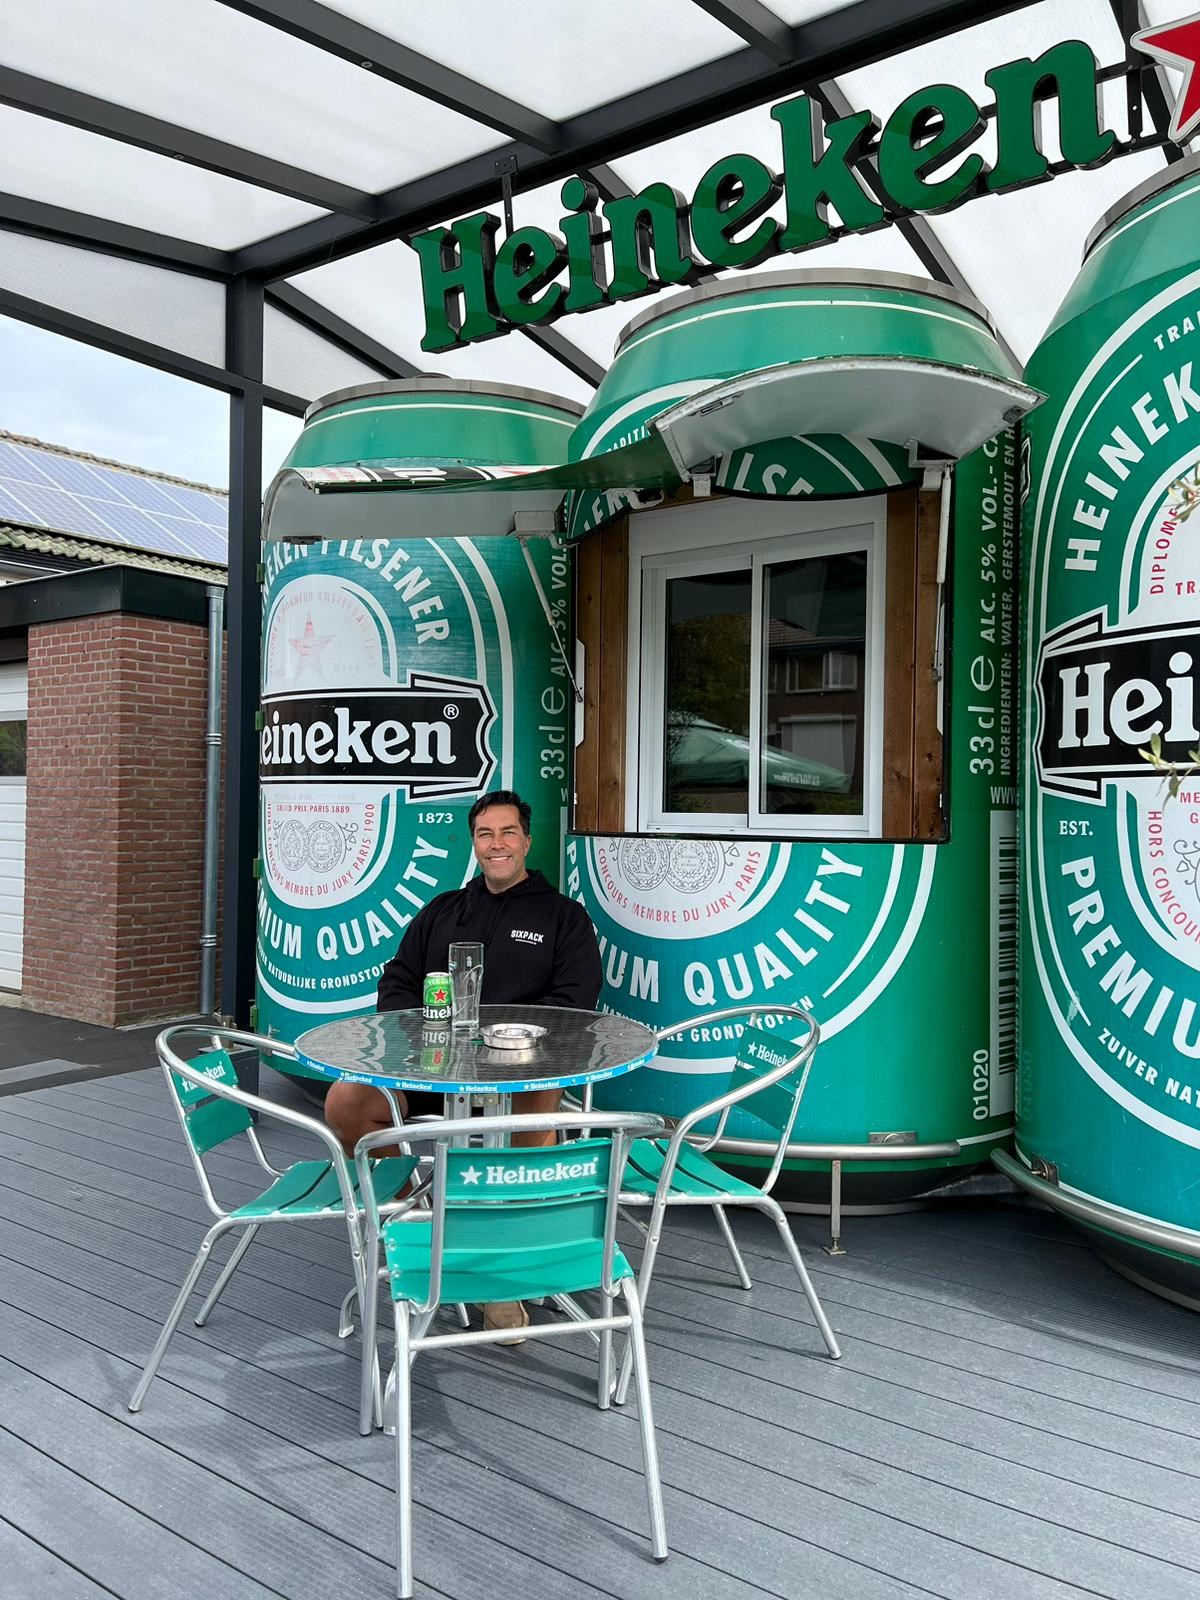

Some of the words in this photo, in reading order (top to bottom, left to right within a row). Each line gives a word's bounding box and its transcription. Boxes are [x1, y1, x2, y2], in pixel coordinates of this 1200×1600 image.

[409, 38, 1116, 352] Heineken
[1154, 311, 1200, 351] TRA
[1004, 444, 1015, 467] EN
[982, 478, 998, 531] VOL.
[1002, 475, 1015, 581] GERSTEMOUT
[981, 543, 997, 583] 5%
[1175, 581, 1200, 595] TR
[980, 592, 997, 643] ALC.
[1001, 587, 1014, 646] WATER,
[1000, 652, 1012, 776] INGREDIENTEN:
[1058, 650, 1200, 749] Hei
[261, 707, 457, 765] eineken
[967, 705, 995, 775] 33cl
[294, 805, 307, 813] PRIX
[309, 805, 330, 813] PARIS
[332, 805, 350, 814] 1889
[417, 813, 454, 824] 1873
[1059, 820, 1094, 836] EST.
[1148, 811, 1164, 858] HORS
[284, 880, 313, 896] MEMBRE
[317, 885, 329, 896] DU
[333, 870, 354, 891] JURY
[352, 838, 372, 871] PARIS
[364, 803, 375, 832] 1900
[317, 835, 449, 961] QUALITY
[598, 847, 628, 909] CONCOURS
[632, 902, 677, 923] MEMBRE
[683, 908, 700, 923] DU
[706, 891, 737, 918] JURY
[735, 850, 761, 892] PARIS
[511, 930, 544, 943] SIXPACK
[683, 847, 863, 1006] QUALITY
[973, 1049, 989, 1121] 01020
[1098, 1027, 1158, 1086] ZUIVER
[486, 1160, 598, 1185] Heineken
